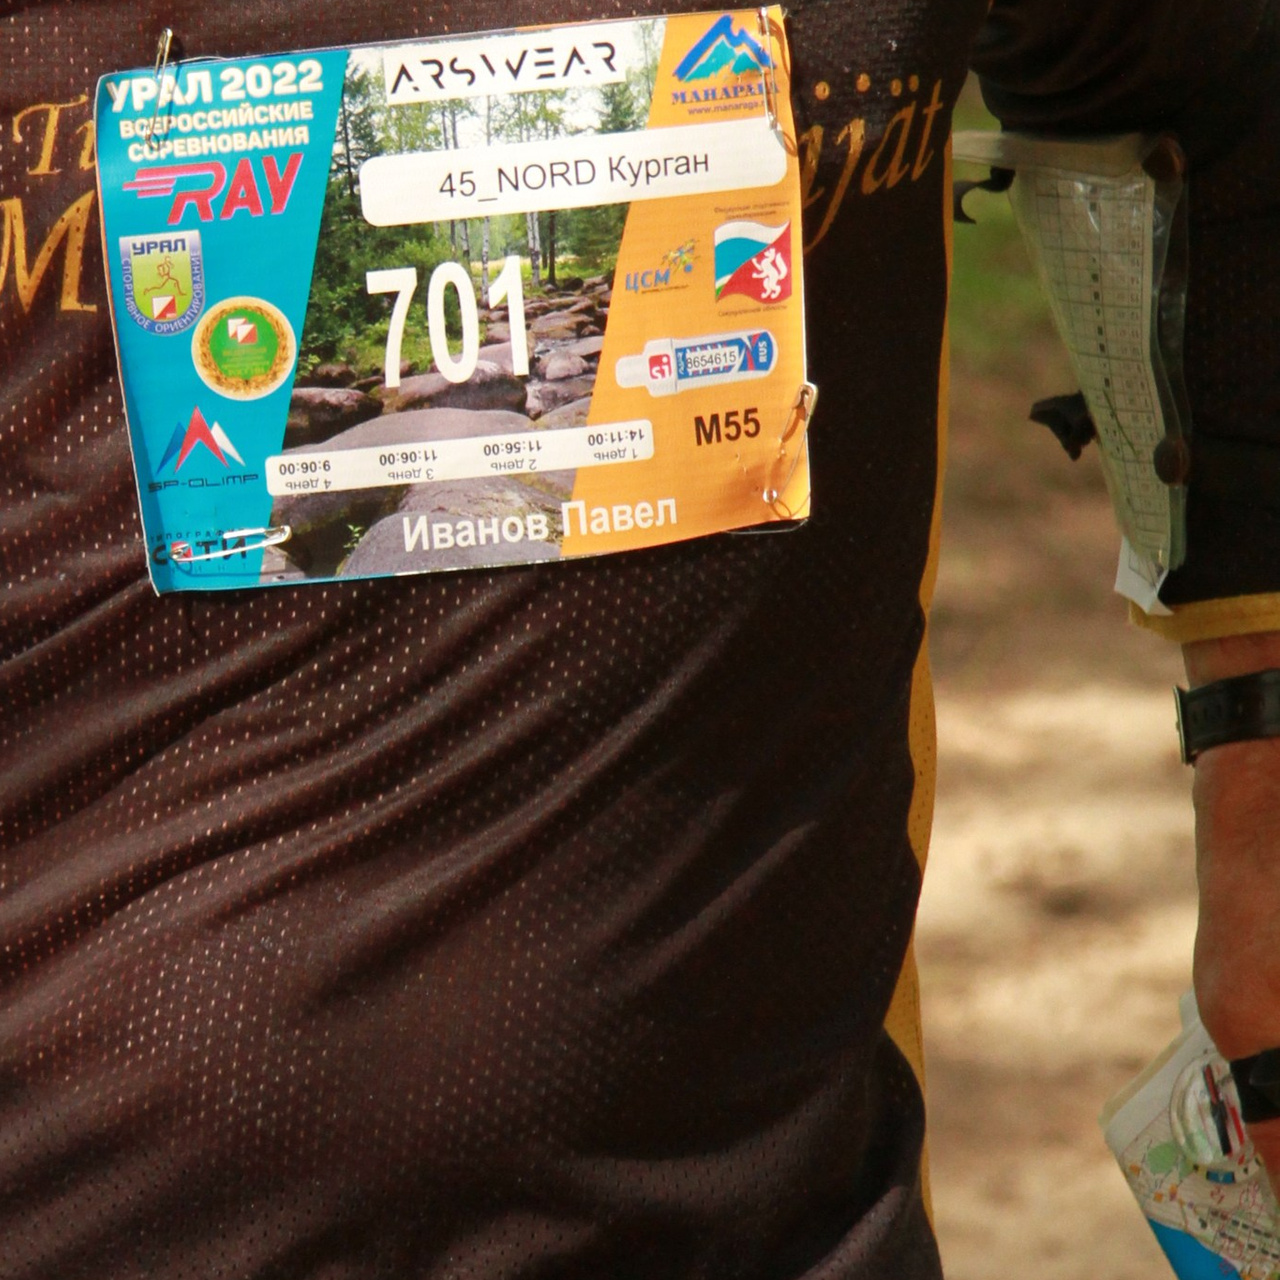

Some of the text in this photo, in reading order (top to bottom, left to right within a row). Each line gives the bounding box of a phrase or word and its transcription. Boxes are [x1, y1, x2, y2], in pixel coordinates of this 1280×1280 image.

[390, 41, 617, 95] ARSWEAR
[105, 59, 324, 113] УРАЛ 2022
[119, 100, 314, 139] ВСЕРОССИЙСКИЕ
[687, 100, 765, 115] www.manaraga.
[127, 125, 310, 163] СОРЕВНОВАНИЯ
[122, 152, 305, 226] RAY
[438, 153, 710, 203] 45_NORD Курган
[131, 237, 188, 256] УРАЛ
[121, 257, 151, 330] СПОРТИВНОЕ
[625, 268, 671, 295] ЦСМ
[366, 253, 530, 389] 701
[685, 350, 737, 370] 8654615
[758, 340, 768, 363] RUS
[483, 440, 543, 457] 11:56:00
[587, 428, 646, 446] 14:11:00
[279, 459, 332, 476] 9:06:00
[379, 449, 438, 466] 11:06:00
[147, 473, 259, 493] SP-OLIMP
[151, 528, 247, 543] ТИПОГРАФ
[402, 498, 678, 553] Иванов Павел
[152, 535, 248, 565] СТИ
